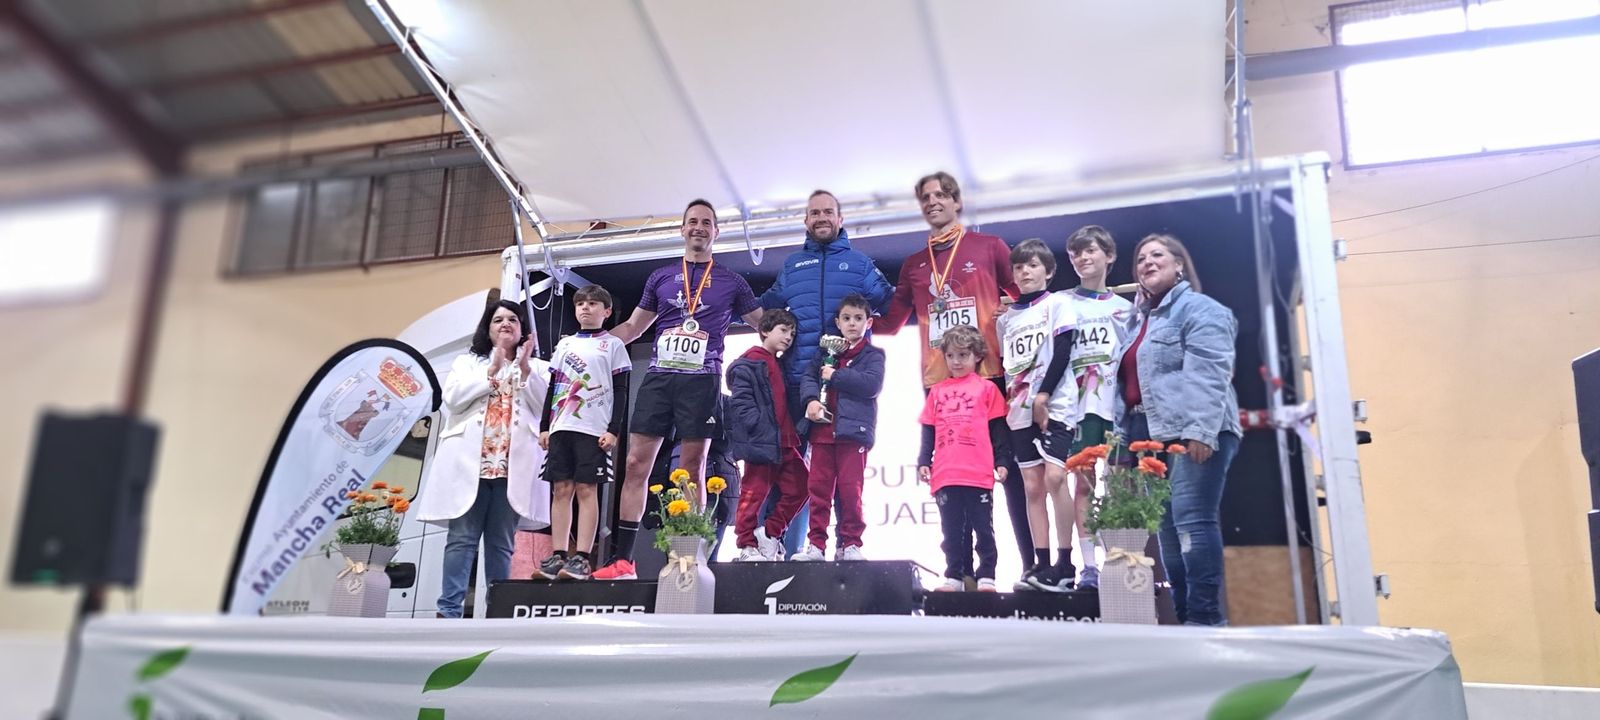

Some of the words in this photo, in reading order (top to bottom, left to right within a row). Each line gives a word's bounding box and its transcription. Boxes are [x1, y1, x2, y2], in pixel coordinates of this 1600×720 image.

[935, 309, 971, 329] 1105
[665, 336, 700, 354] 1100
[273, 473, 337, 543] Ayuntamiento
[335, 460, 349, 474] de
[877, 502, 940, 526] JAE
[252, 515, 327, 596] Mancha
[321, 468, 366, 515] Real
[778, 603, 827, 611] DIPUTACIÓN
